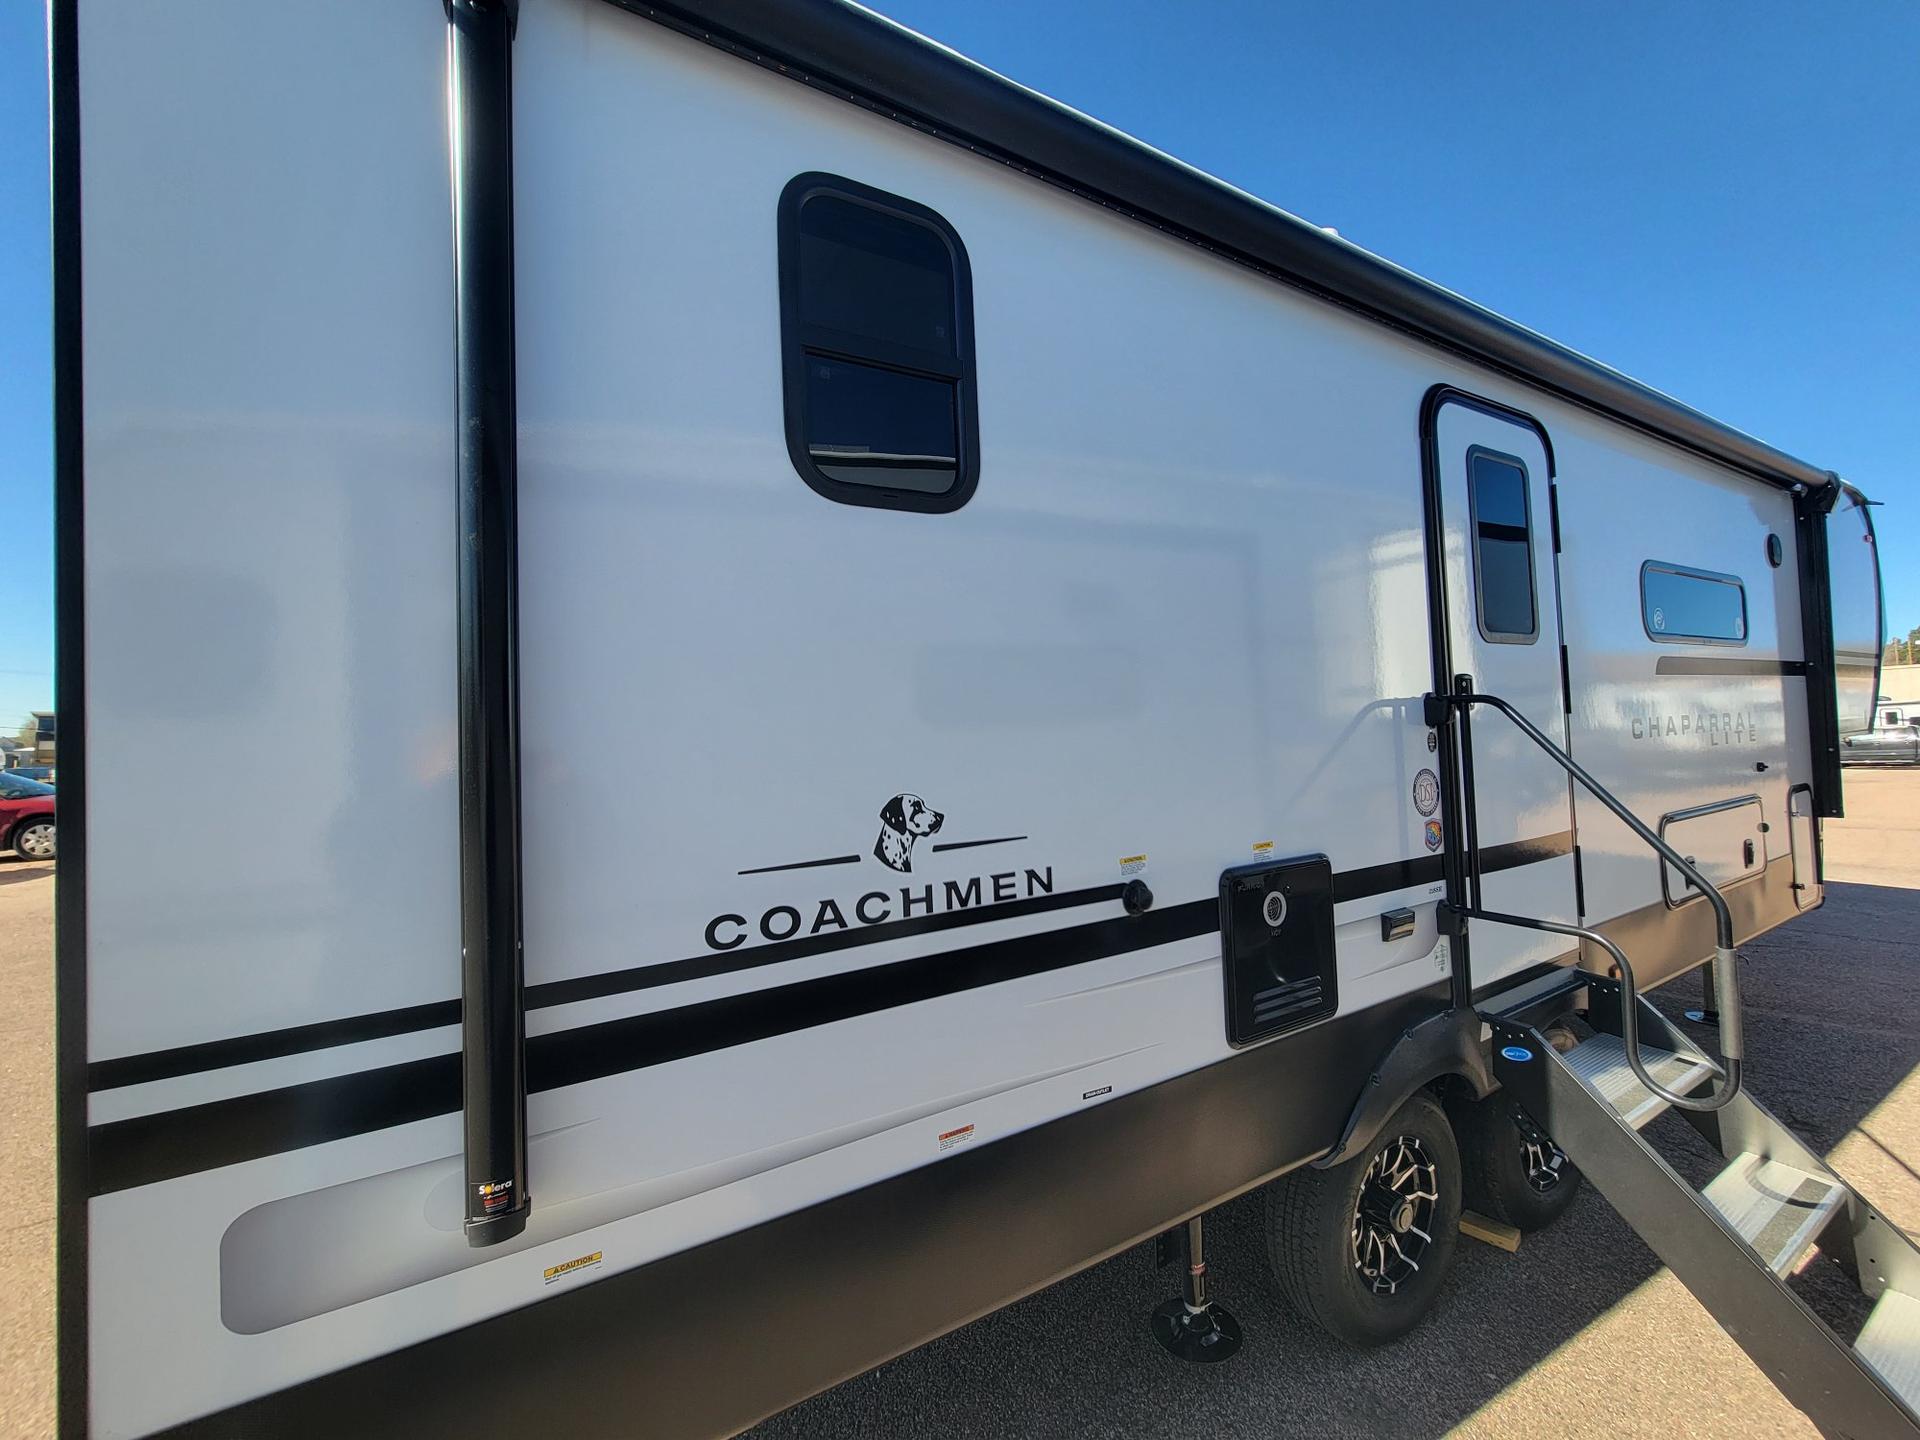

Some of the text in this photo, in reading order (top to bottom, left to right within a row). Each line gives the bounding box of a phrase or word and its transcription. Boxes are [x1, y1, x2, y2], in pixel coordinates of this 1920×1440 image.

[1631, 711, 1756, 740] CHAPARRAL
[1710, 729, 1757, 747] LITE
[704, 866, 1054, 951] COACHMEN
[479, 1180, 513, 1195] Solera
[559, 1254, 594, 1272] CAUTION
